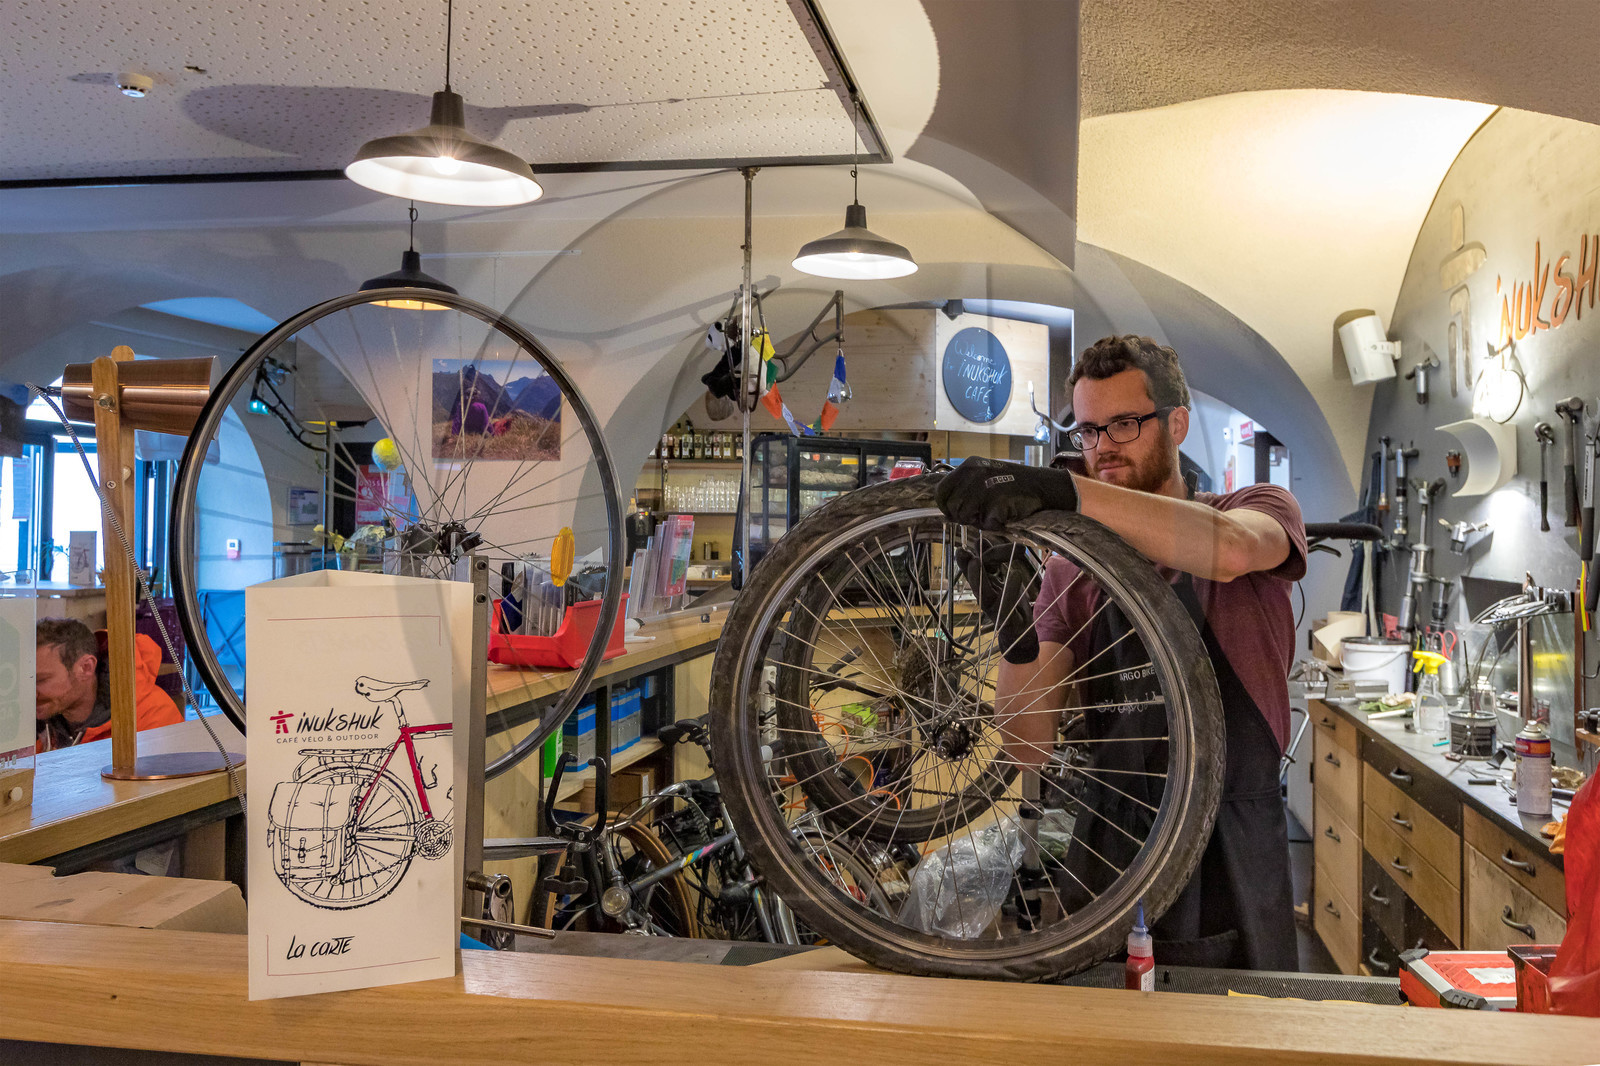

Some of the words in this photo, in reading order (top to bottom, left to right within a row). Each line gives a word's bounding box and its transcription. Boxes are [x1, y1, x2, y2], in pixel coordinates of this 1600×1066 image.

[276, 736, 298, 744] CAFÉ
[302, 735, 324, 743] VÉLO
[286, 934, 306, 960] La
